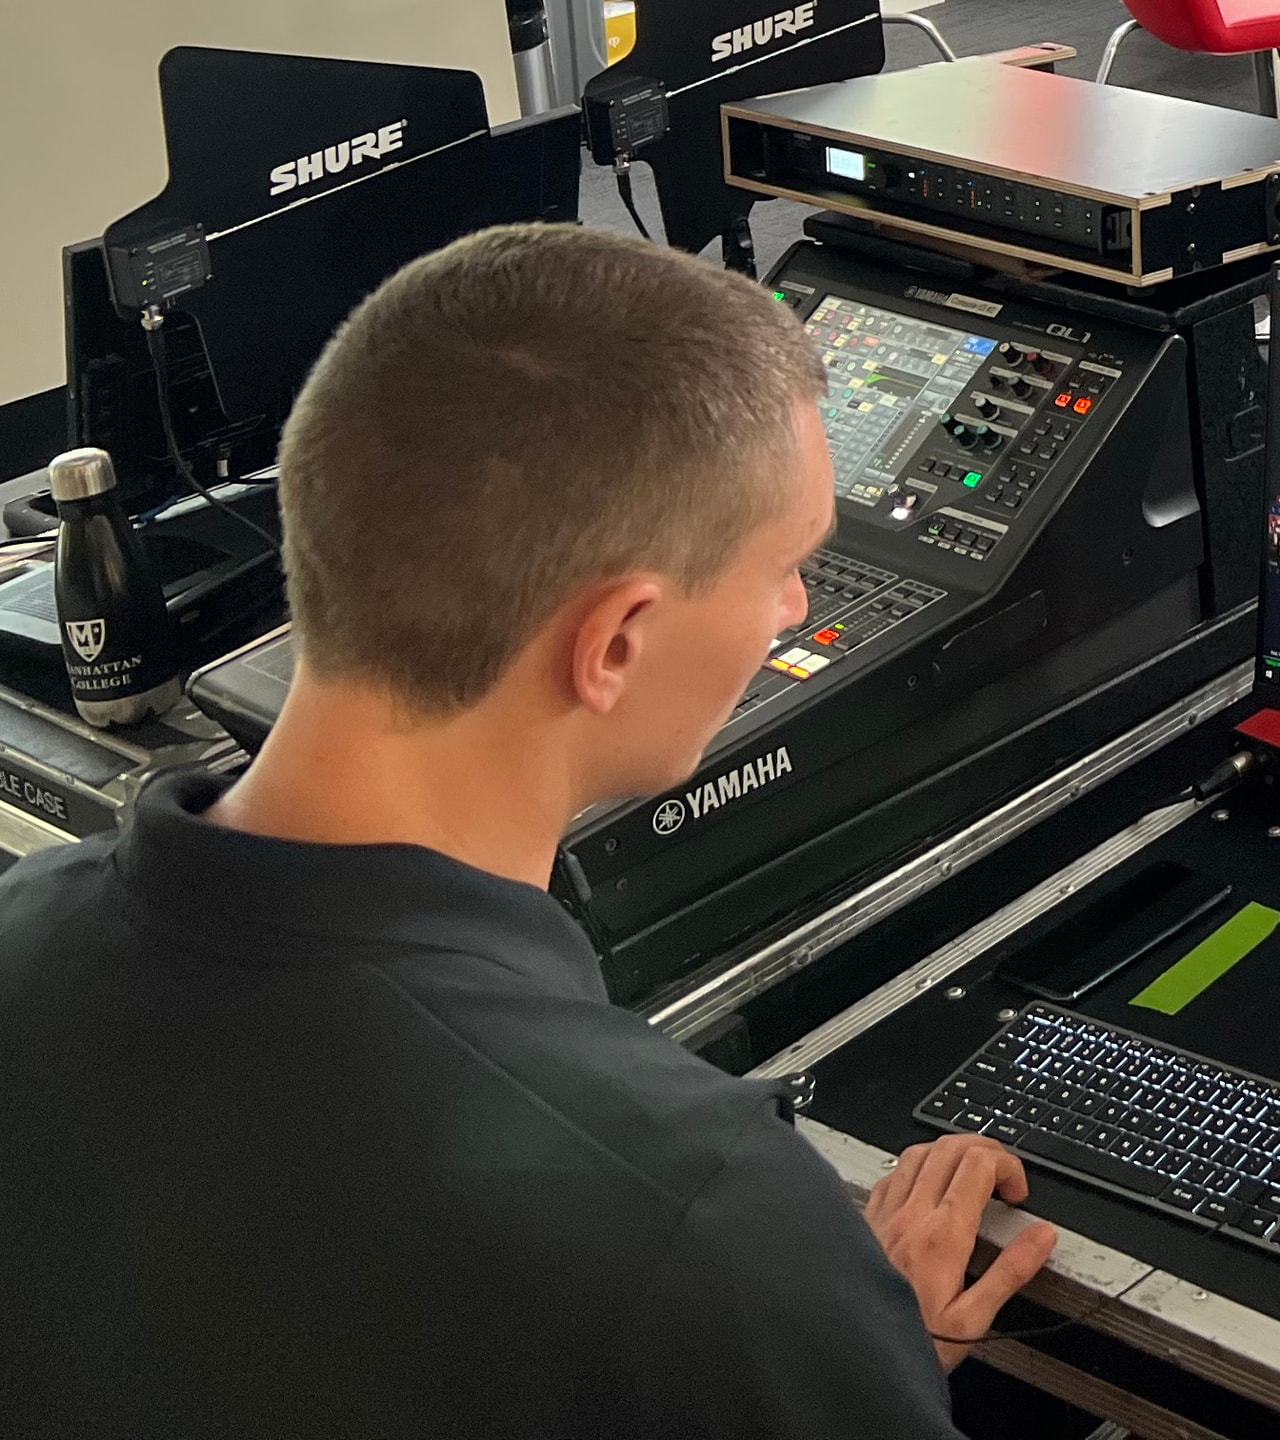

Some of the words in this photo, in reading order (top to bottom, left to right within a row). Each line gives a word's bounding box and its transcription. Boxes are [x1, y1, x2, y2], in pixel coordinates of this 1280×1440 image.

[711, 0, 815, 62] SHURE
[270, 120, 404, 196] SHURE
[24, 782, 67, 819] CASE
[686, 746, 793, 819] YAMAHA
